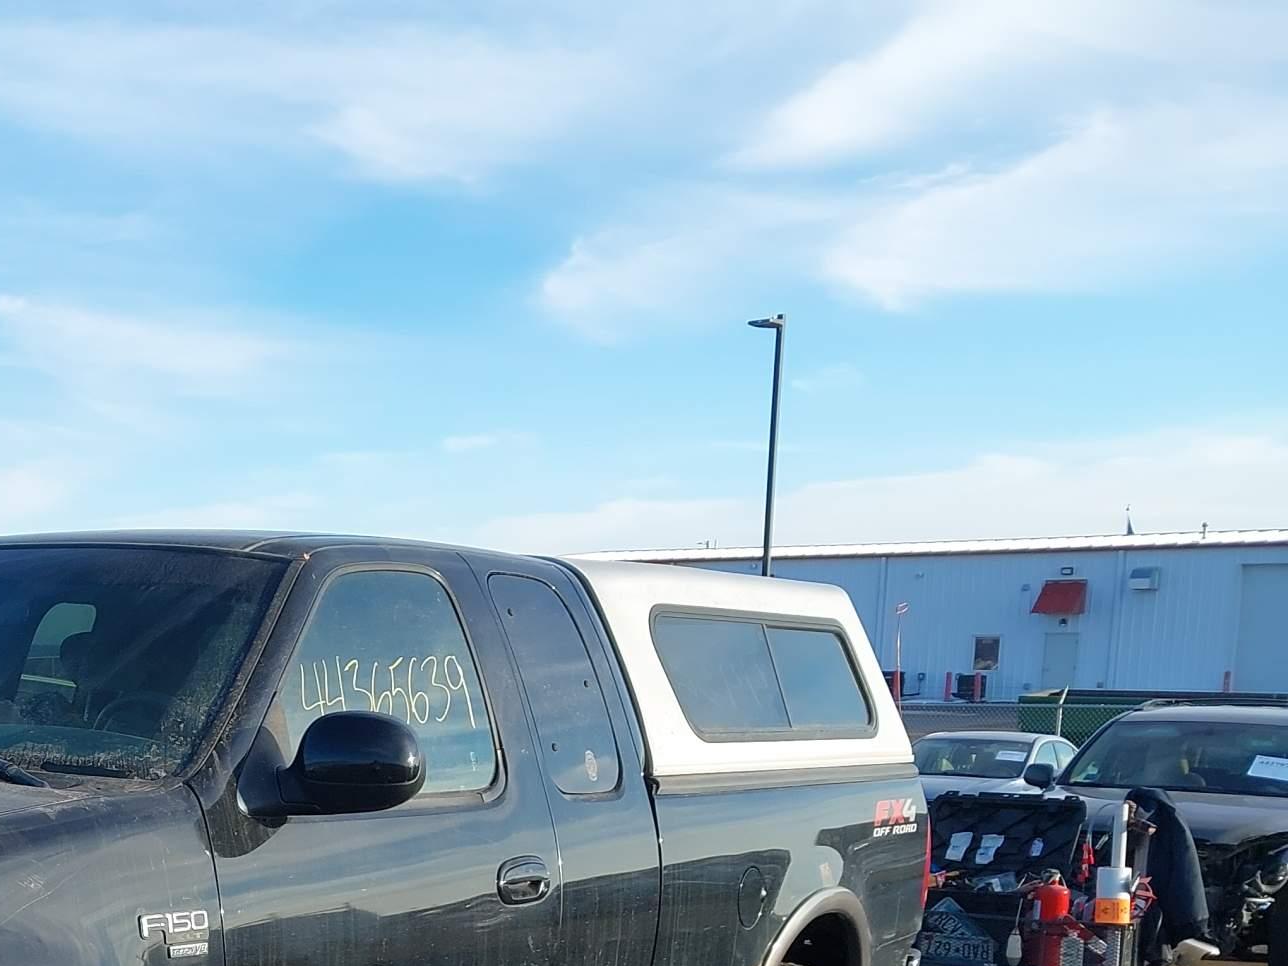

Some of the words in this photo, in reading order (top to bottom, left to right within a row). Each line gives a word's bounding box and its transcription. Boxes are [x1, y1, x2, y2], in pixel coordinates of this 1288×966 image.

[299, 655, 477, 729] 44365639
[873, 798, 917, 827] FX4
[872, 826, 892, 838] OFF
[892, 823, 918, 835] ROAD
[141, 910, 209, 938] F-150
